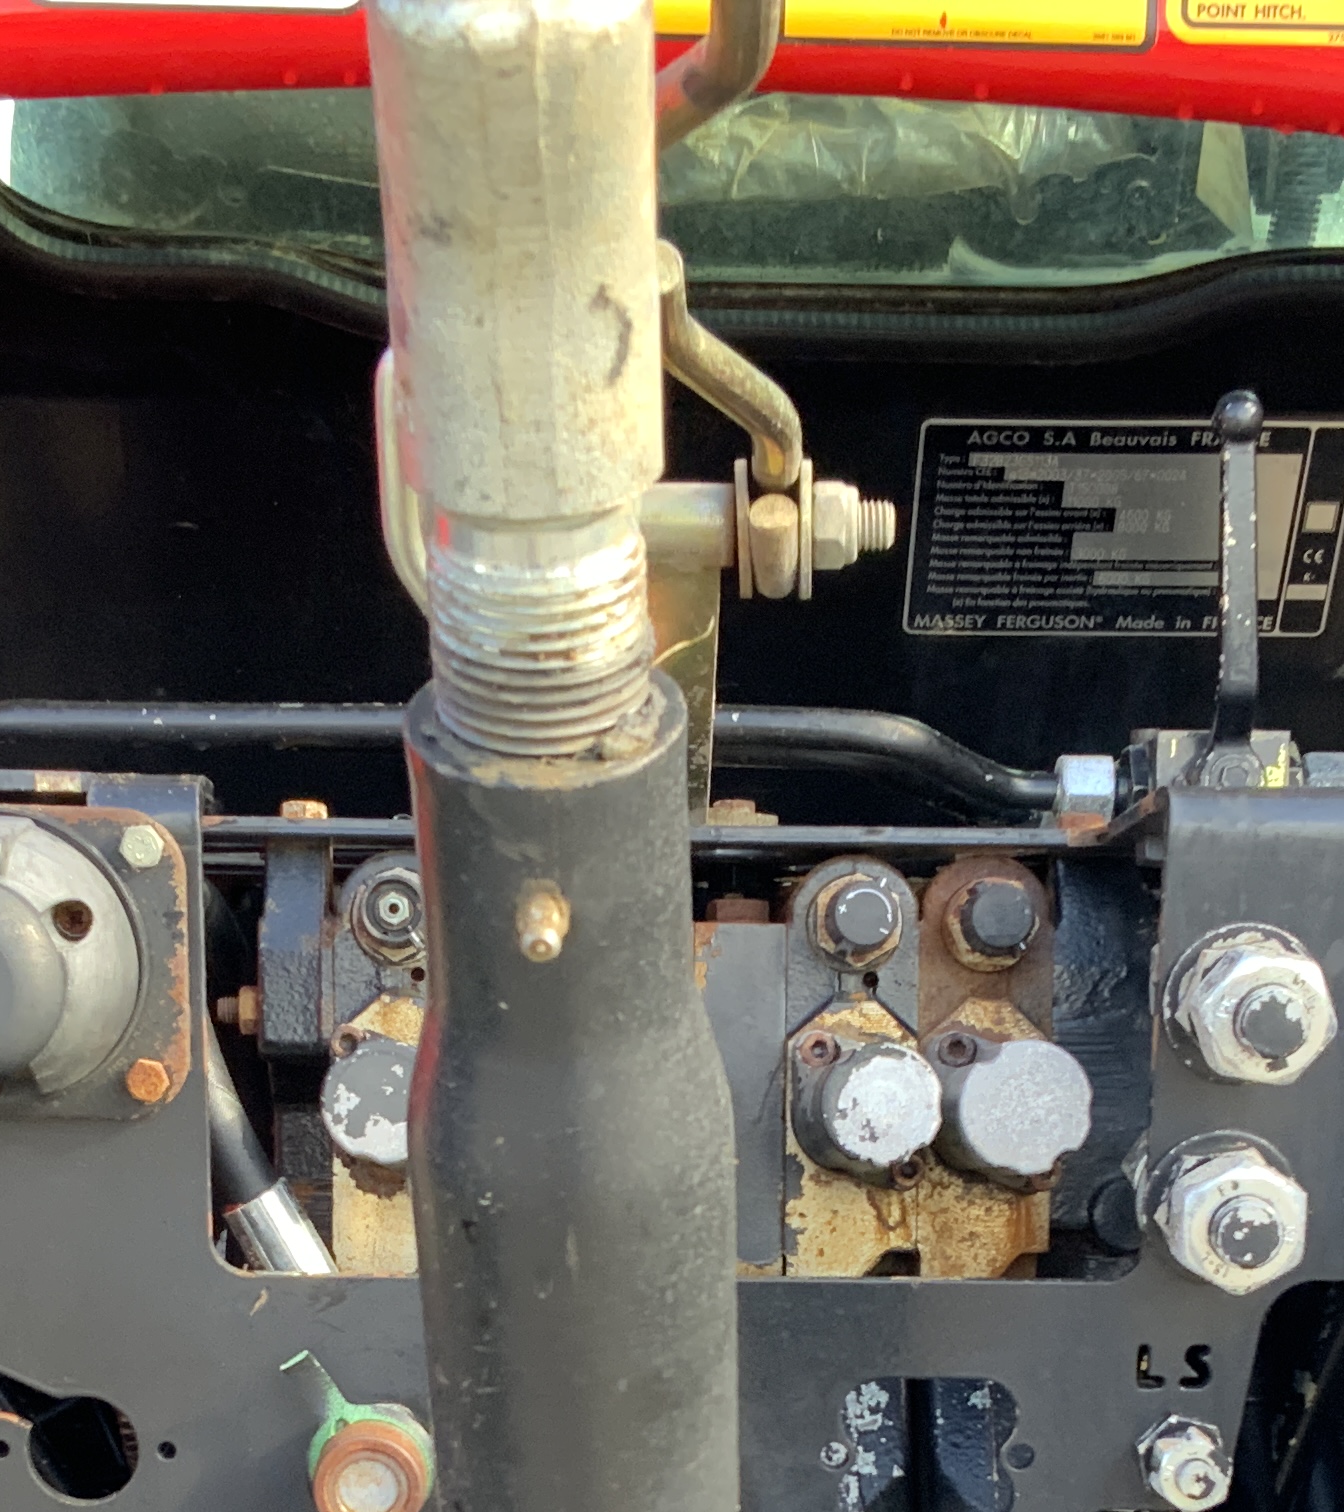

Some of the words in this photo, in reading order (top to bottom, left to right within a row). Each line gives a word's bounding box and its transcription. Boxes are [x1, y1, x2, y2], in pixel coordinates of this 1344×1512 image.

[1197, 4, 1246, 18] POINT
[967, 430, 1030, 446] AGCO
[1043, 431, 1077, 447] S.A
[1090, 431, 1178, 447] Beauvais
[914, 614, 987, 629] MASSEY
[1115, 615, 1165, 630] Made
[1176, 615, 1192, 630] in
